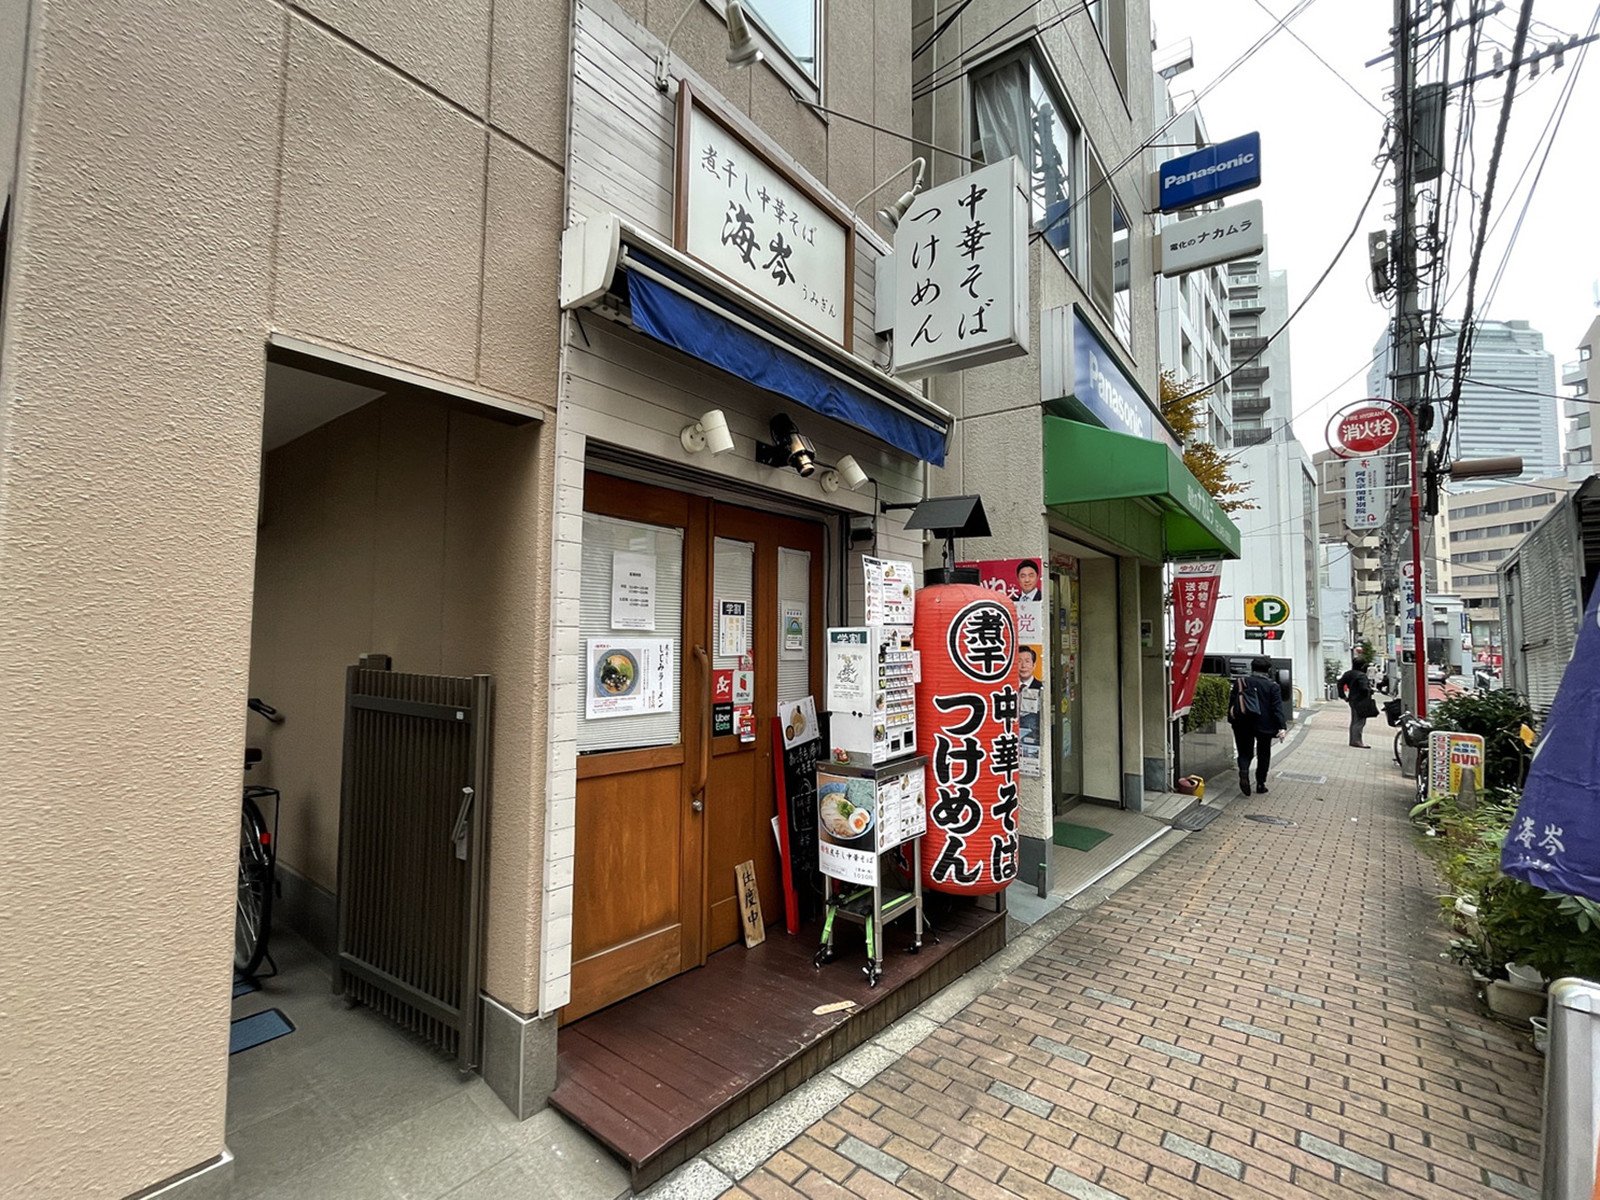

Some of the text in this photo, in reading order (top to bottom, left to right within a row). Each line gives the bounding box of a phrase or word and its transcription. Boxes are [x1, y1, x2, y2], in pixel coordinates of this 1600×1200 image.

[1164, 153, 1255, 189] Panasonic
[702, 144, 818, 247] 煮干し中華そば
[1170, 220, 1252, 251] 電化のナカムラ
[910, 208, 943, 348] つけめん
[955, 183, 995, 340] 中華そば
[802, 284, 837, 318] うみぎん
[1089, 350, 1144, 438] Panasonic
[1342, 418, 1393, 442] 消火栓
[1359, 411, 1387, 420] HYDRANT
[1184, 581, 1196, 616] 送るなら
[1263, 602, 1281, 621] P
[715, 714, 730, 722] Uber
[715, 723, 730, 731] Eats
[1452, 753, 1479, 765] DVD
[931, 692, 988, 886] つけめん
